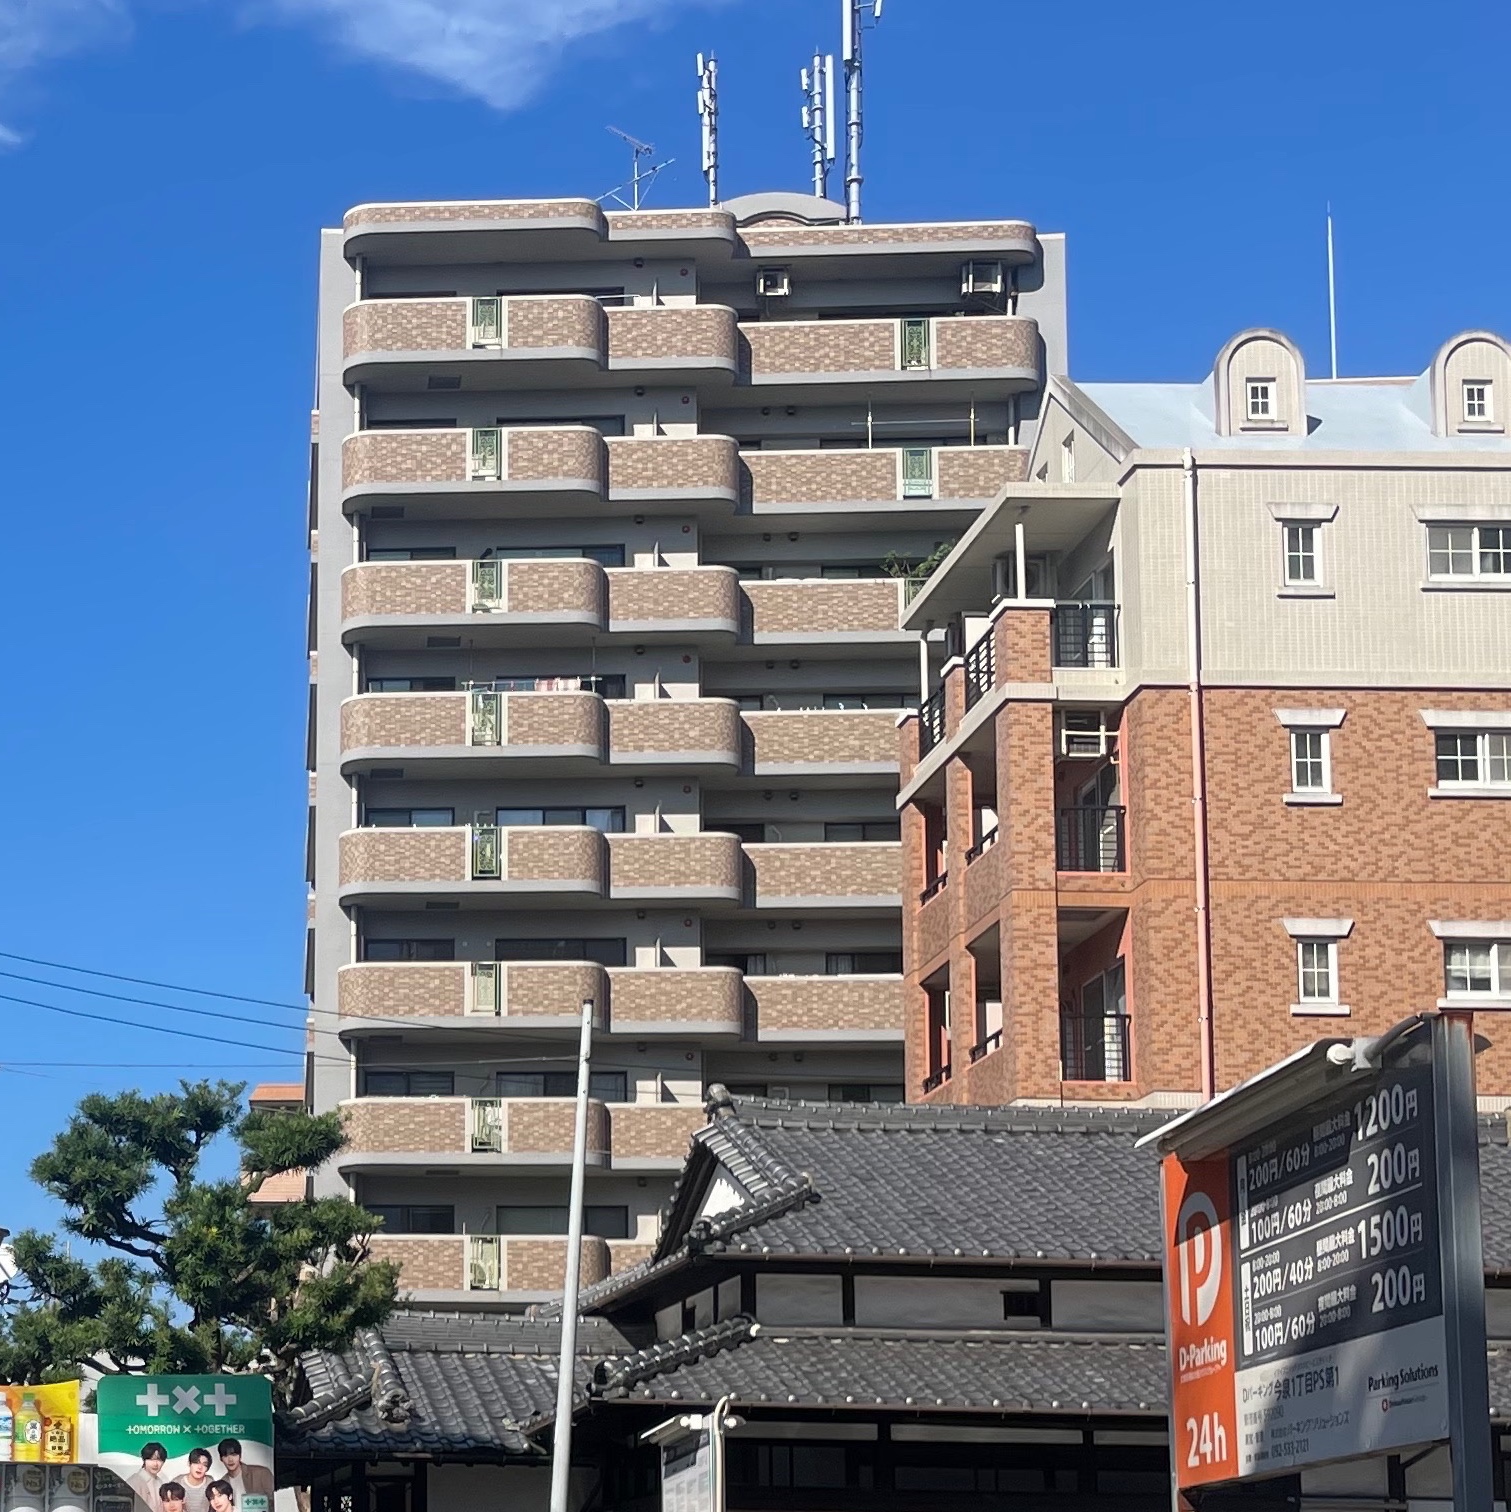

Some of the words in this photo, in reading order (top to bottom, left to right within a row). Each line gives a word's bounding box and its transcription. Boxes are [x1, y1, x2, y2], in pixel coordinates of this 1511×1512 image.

[1354, 1083, 1418, 1142] 1200円
[1249, 1142, 1310, 1191] 200円/60分
[1367, 1142, 1420, 1197] 200円
[1250, 1198, 1312, 1245] 100円/60分
[1356, 1204, 1423, 1260] 1500円
[1253, 1255, 1314, 1300] 200円/40分
[1370, 1264, 1426, 1313] 200円
[1179, 1336, 1227, 1371] D-Parking
[1254, 1311, 1316, 1353] 100円/60分
[1368, 1369, 1399, 1392] Parking
[1399, 1362, 1439, 1386] Solutions
[1186, 1411, 1227, 1468] 24h
